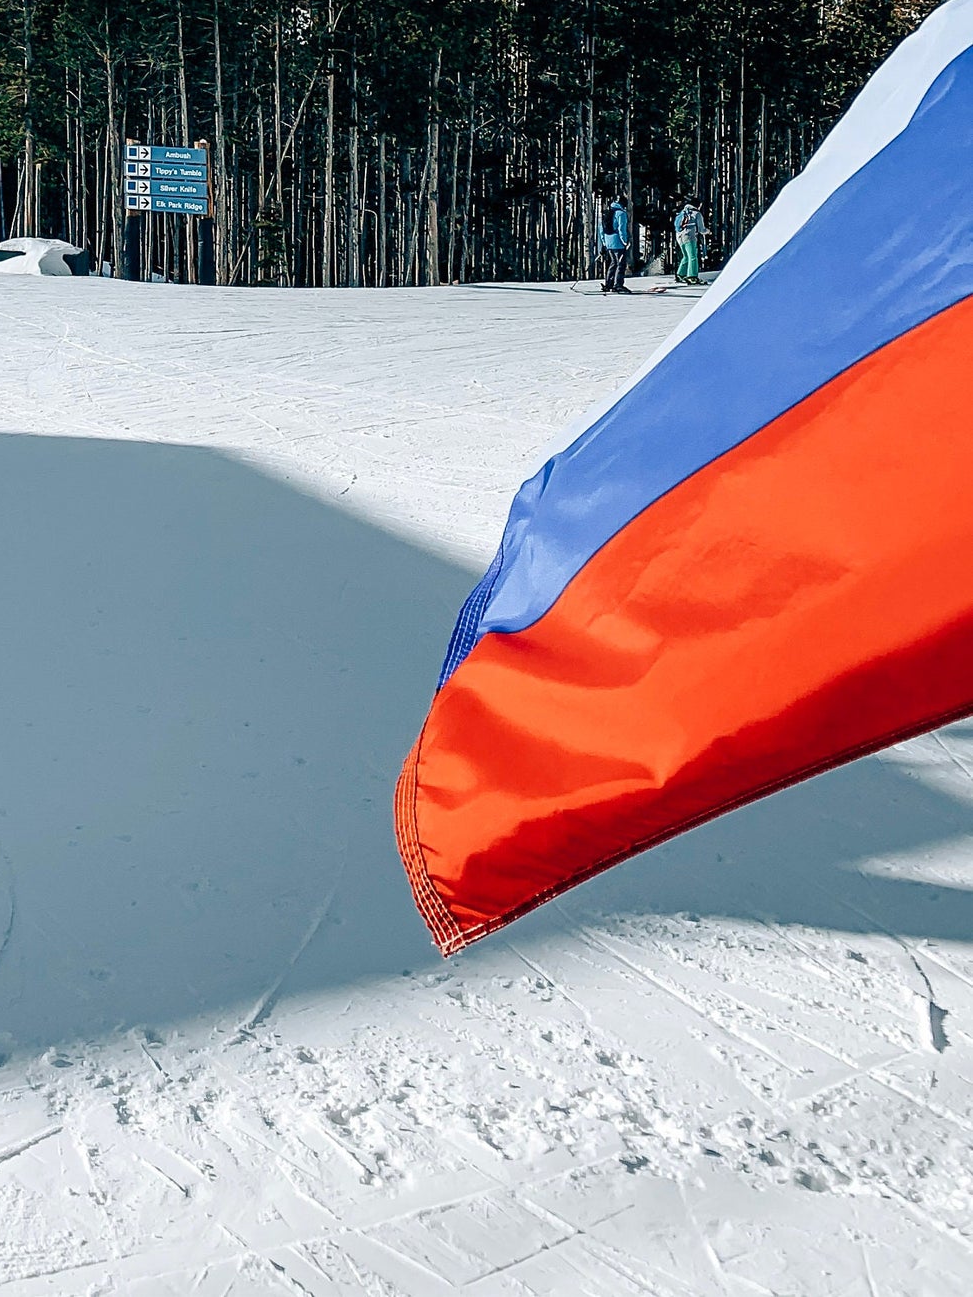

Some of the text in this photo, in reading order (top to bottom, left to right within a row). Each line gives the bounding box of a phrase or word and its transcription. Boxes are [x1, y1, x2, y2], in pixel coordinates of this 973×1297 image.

[165, 151, 191, 159] Ambush
[155, 167, 202, 176] Tippy's Tumble
[179, 185, 197, 193] Knife
[155, 200, 203, 211] Elk Park Ridge
